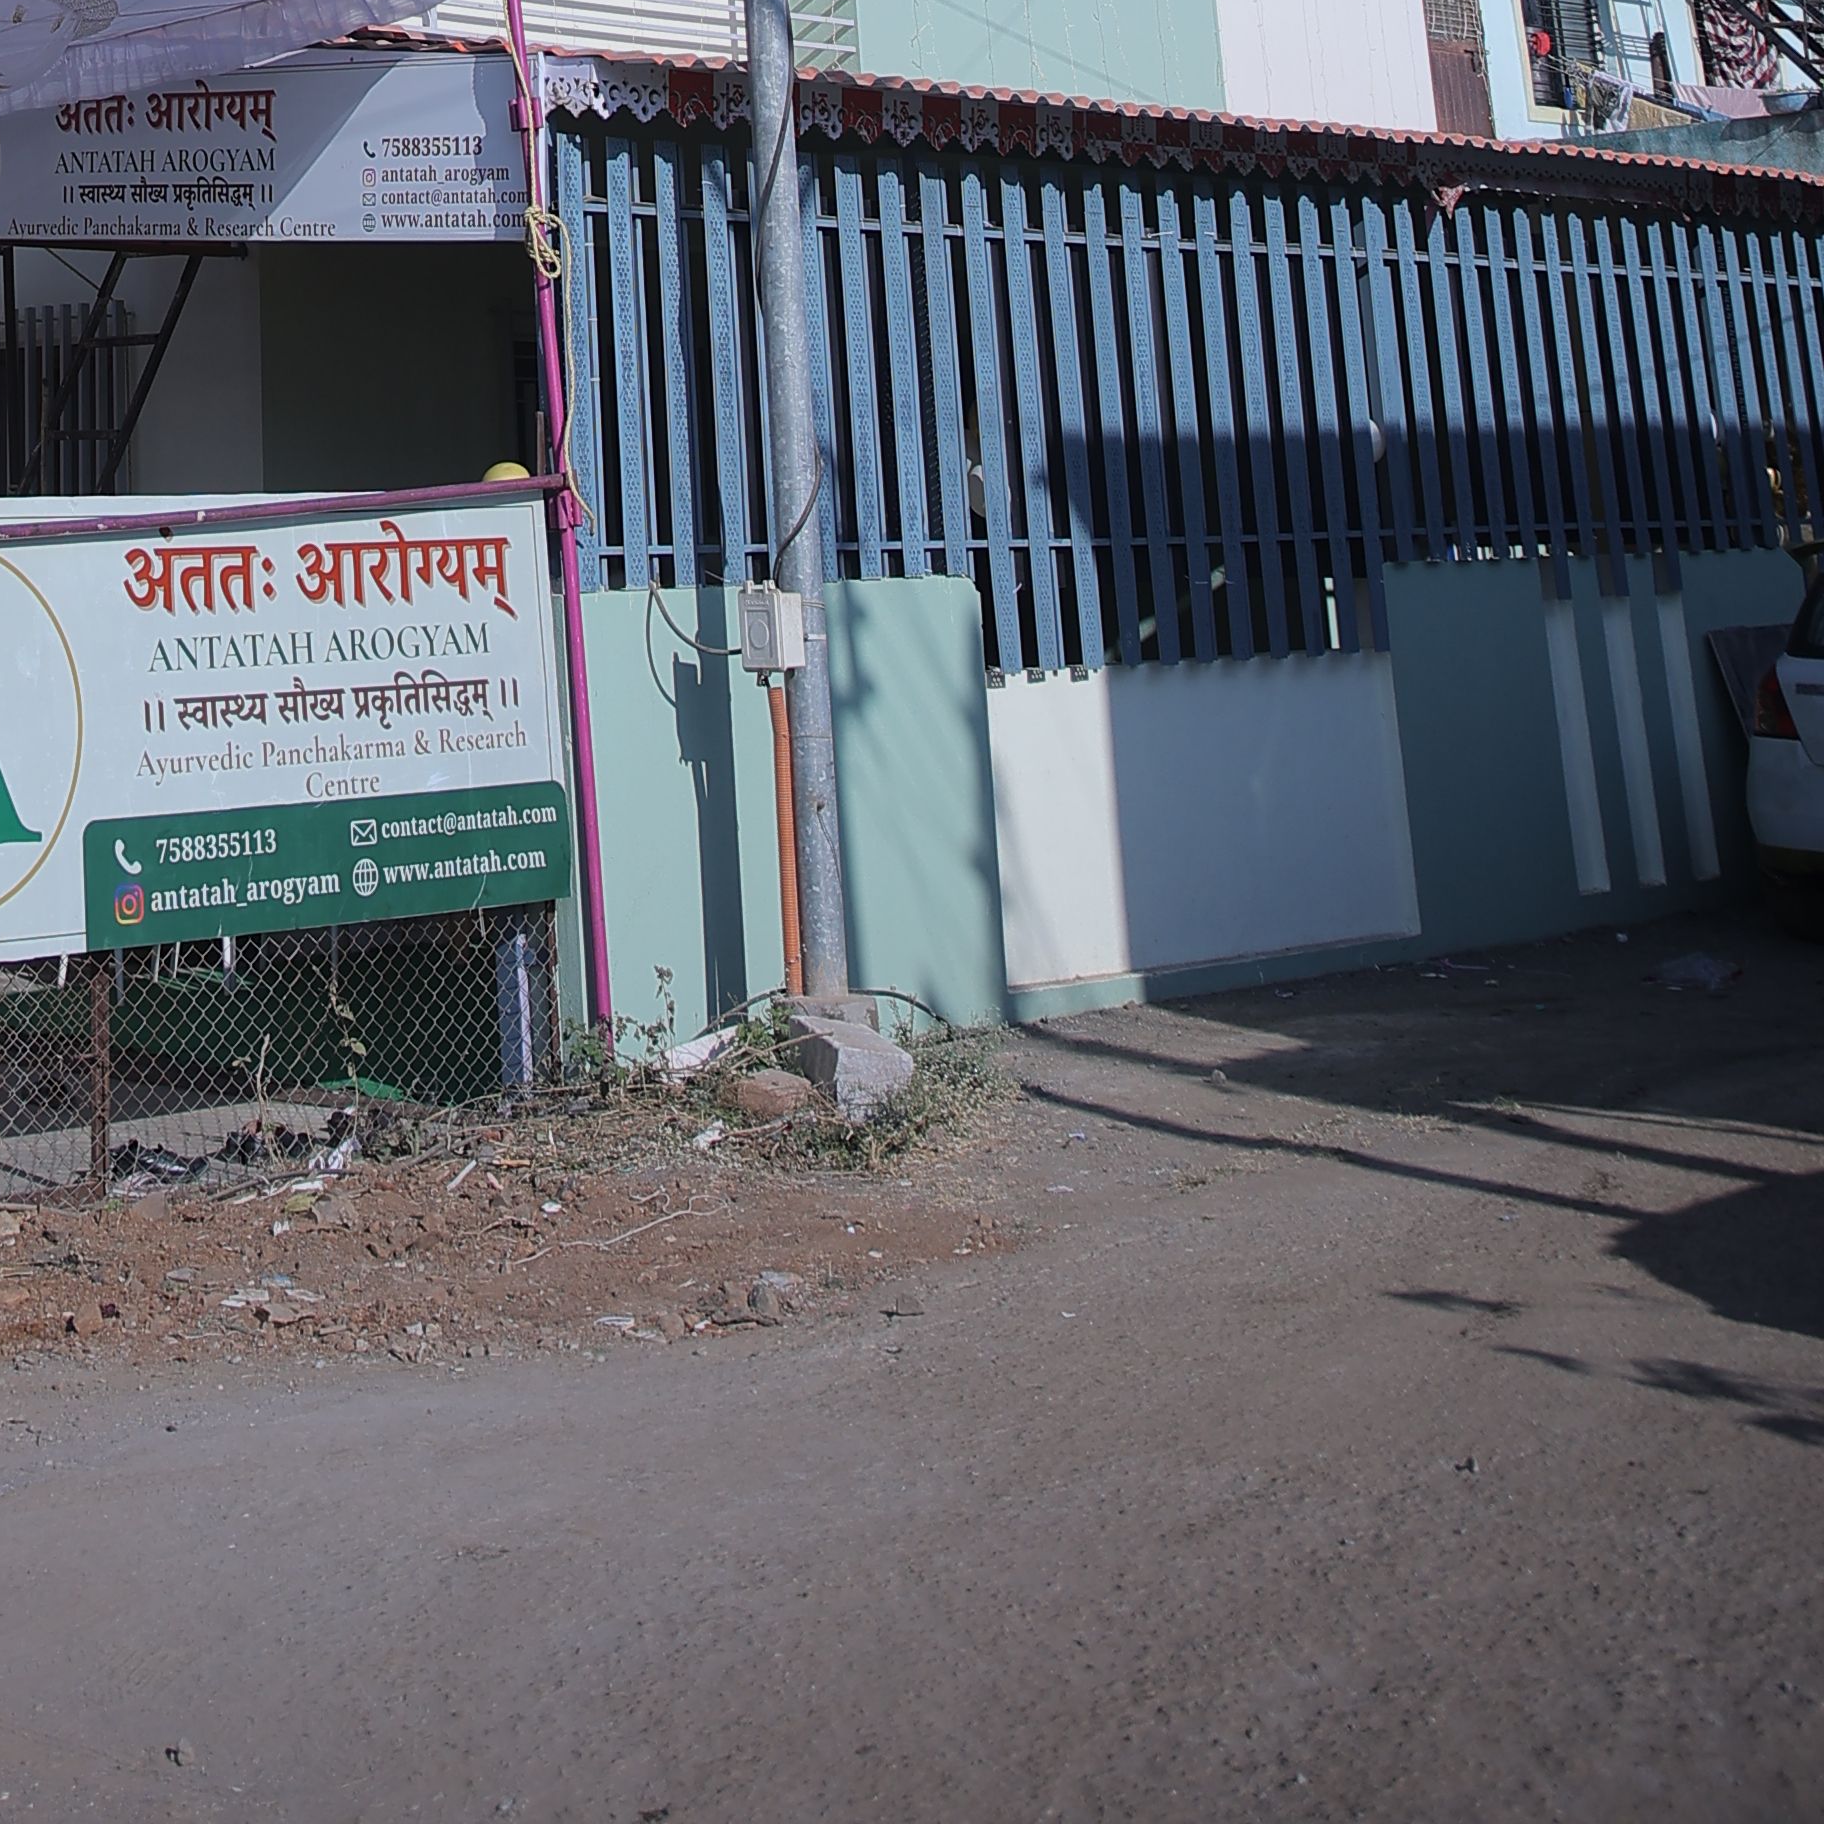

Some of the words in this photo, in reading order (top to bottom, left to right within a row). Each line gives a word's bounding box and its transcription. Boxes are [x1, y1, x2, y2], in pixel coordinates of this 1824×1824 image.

[145, 80, 277, 142] आरोग्यम्
[55, 149, 156, 174] ANTATAH
[161, 147, 276, 173] AROGYAM
[381, 135, 483, 158] 7588355113
[130, 175, 168, 204] सौख्य
[381, 165, 510, 186] antatah_arogyam
[8, 216, 79, 239] Ayurvedic
[83, 215, 181, 237] Panchakarma
[186, 217, 200, 237] &
[205, 215, 275, 237] Research
[279, 216, 337, 237] Centre
[123, 526, 278, 615] अंततः
[296, 520, 519, 620] आरोग्यम्
[148, 631, 313, 673] ANTATAH
[324, 622, 491, 664] AROGYAM
[174, 692, 268, 731] स्वास्थ्य
[274, 677, 346, 723] सौख्य
[136, 740, 254, 787] Ayurvedic
[261, 732, 406, 768] Panchakarma
[413, 729, 433, 754] &
[439, 720, 528, 754] Research
[305, 772, 381, 800] Centre
[381, 803, 558, 840] contact@antatah.com
[155, 828, 278, 865] 7588355113
[383, 848, 547, 886] www.antatah.com
[150, 870, 341, 912] antatah_arogyam
